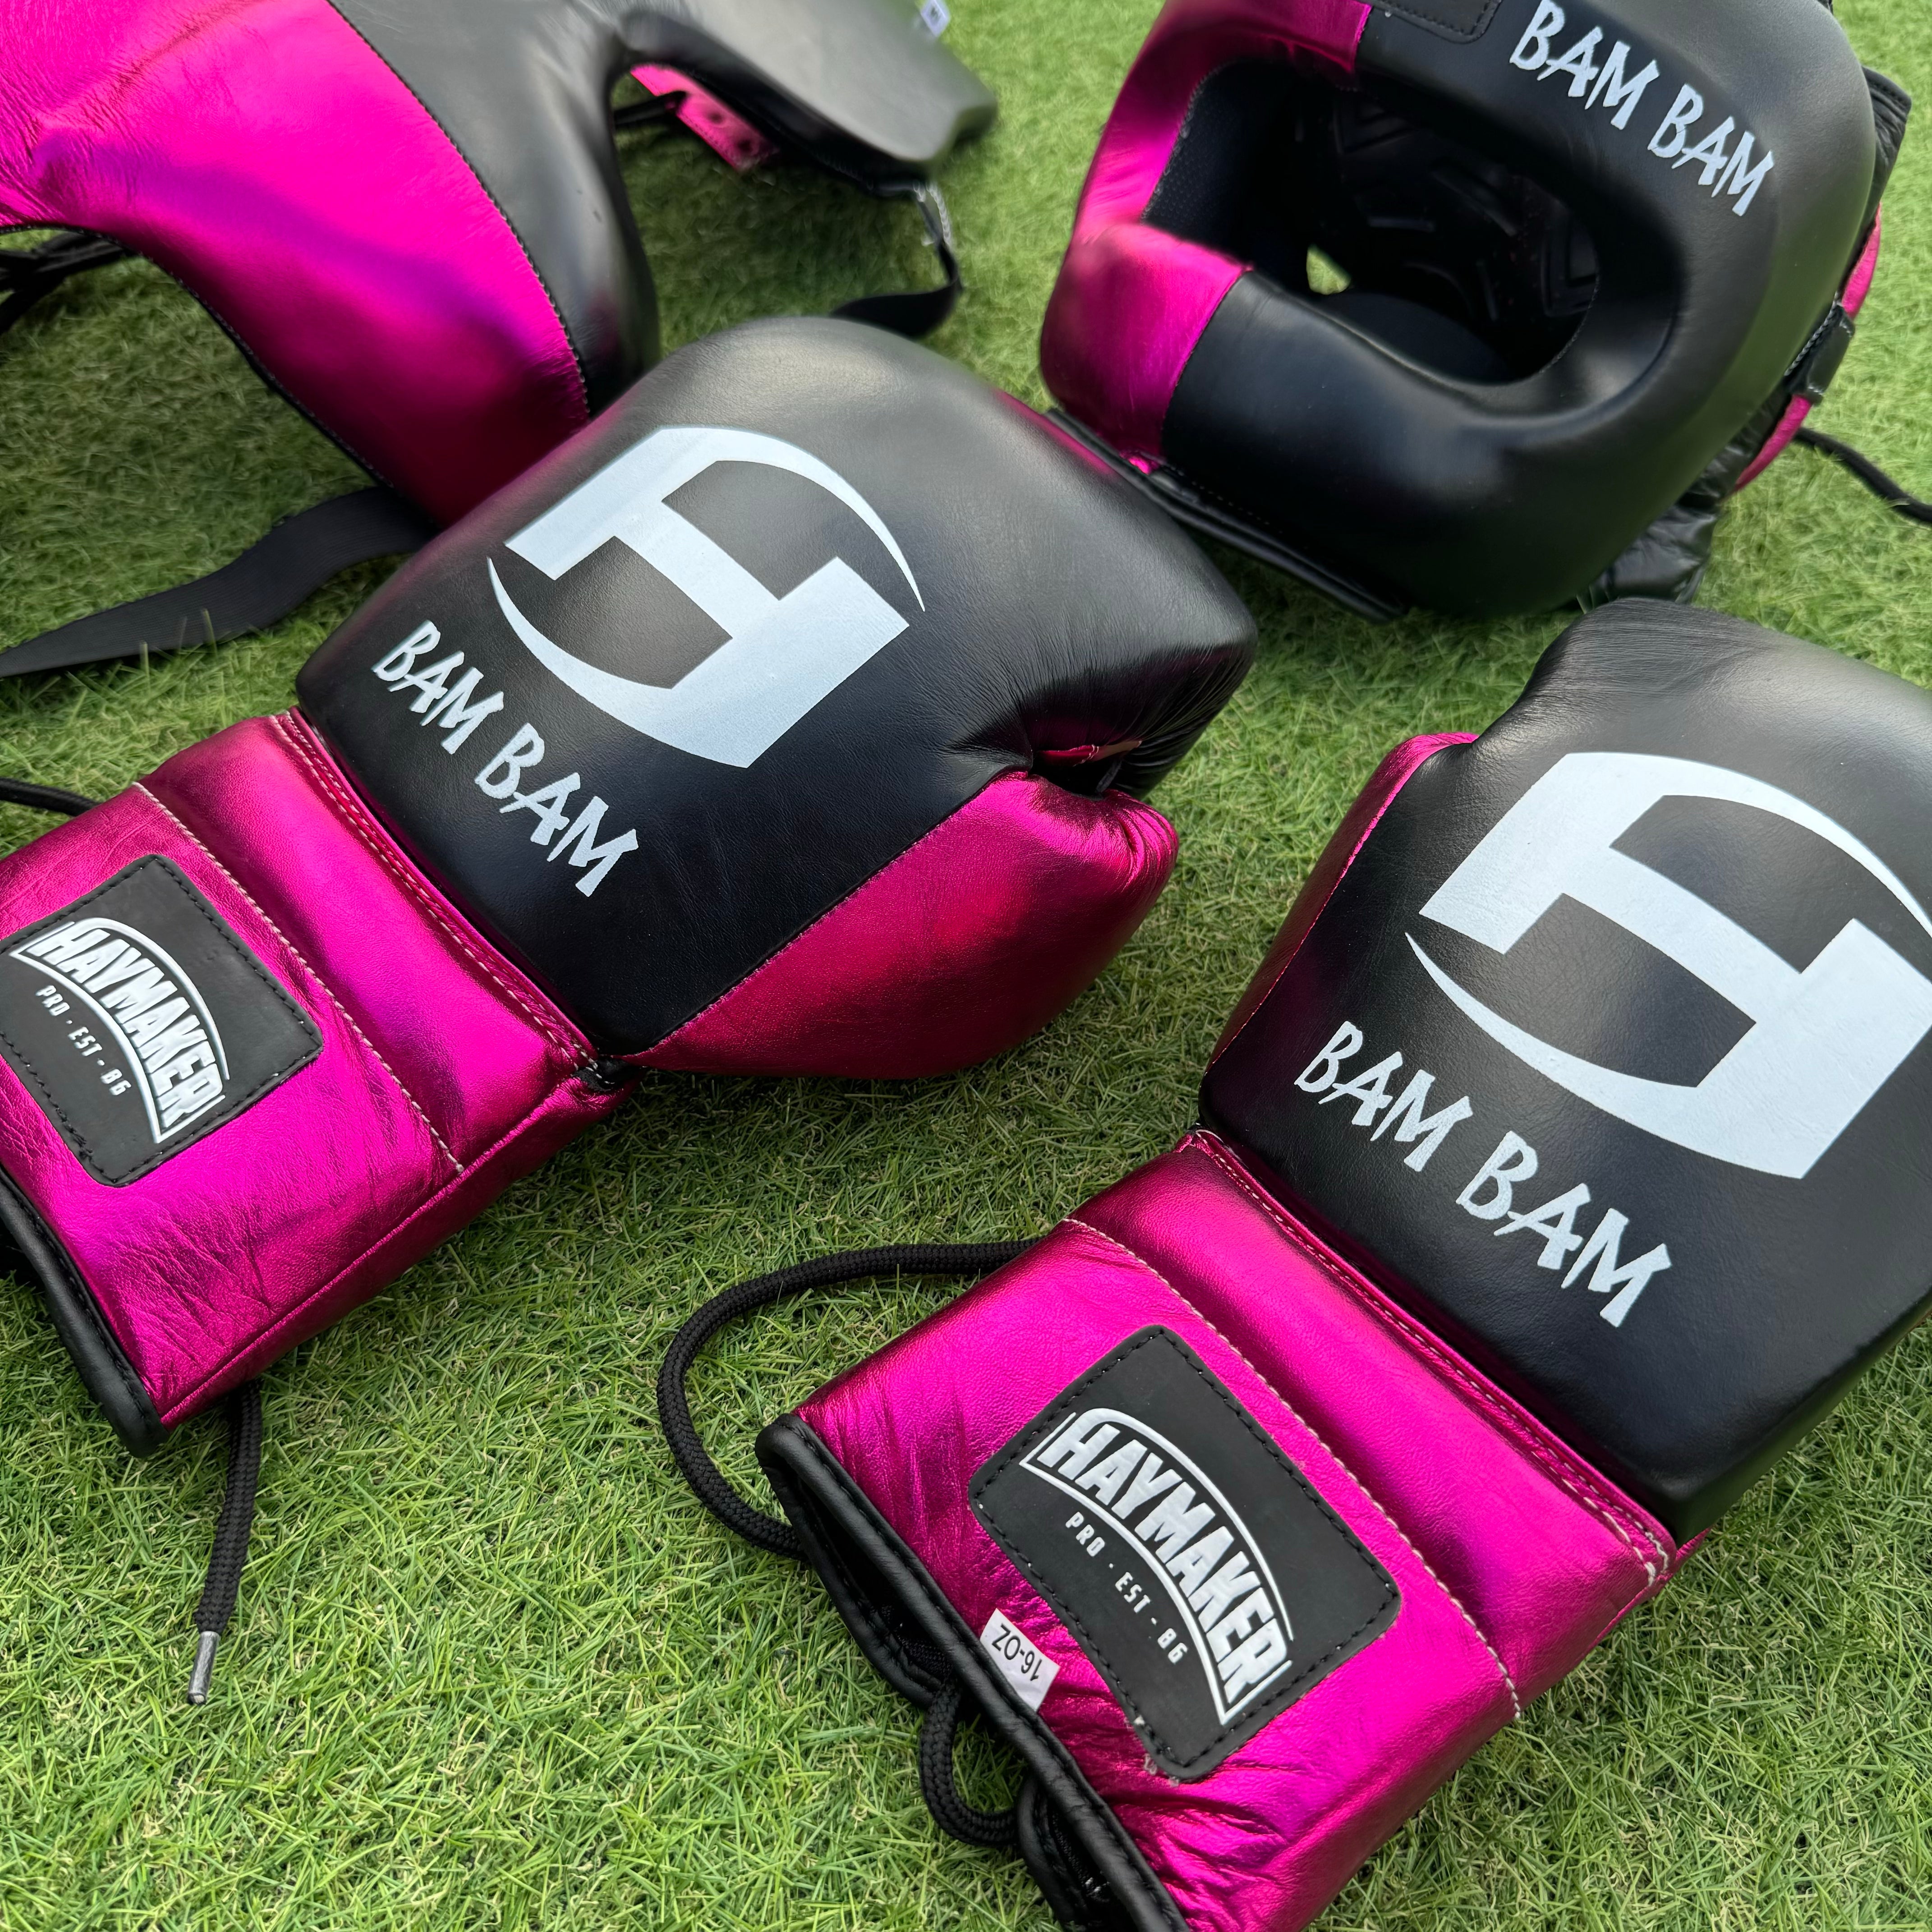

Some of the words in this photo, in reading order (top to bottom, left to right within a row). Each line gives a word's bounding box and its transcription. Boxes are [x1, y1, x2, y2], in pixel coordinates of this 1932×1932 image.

[1510, 0, 1660, 130] BAM
[1647, 84, 1775, 216] BAM
[373, 621, 504, 755] BAM
[474, 722, 639, 897] BAM
[27, 918, 225, 1128] HAYMAKER
[36, 985, 70, 1017] PRO
[68, 1026, 102, 1056] EST
[1293, 1021, 1473, 1172] BAM
[1455, 1130, 1671, 1327] BAM
[991, 1623, 1042, 1681] 16-OZ
[1037, 1409, 1287, 1703] HAYMAKER
[1065, 1511, 1105, 1557] PRO
[1115, 1572, 1151, 1613] EST
[1157, 1628, 1188, 1664] 86
